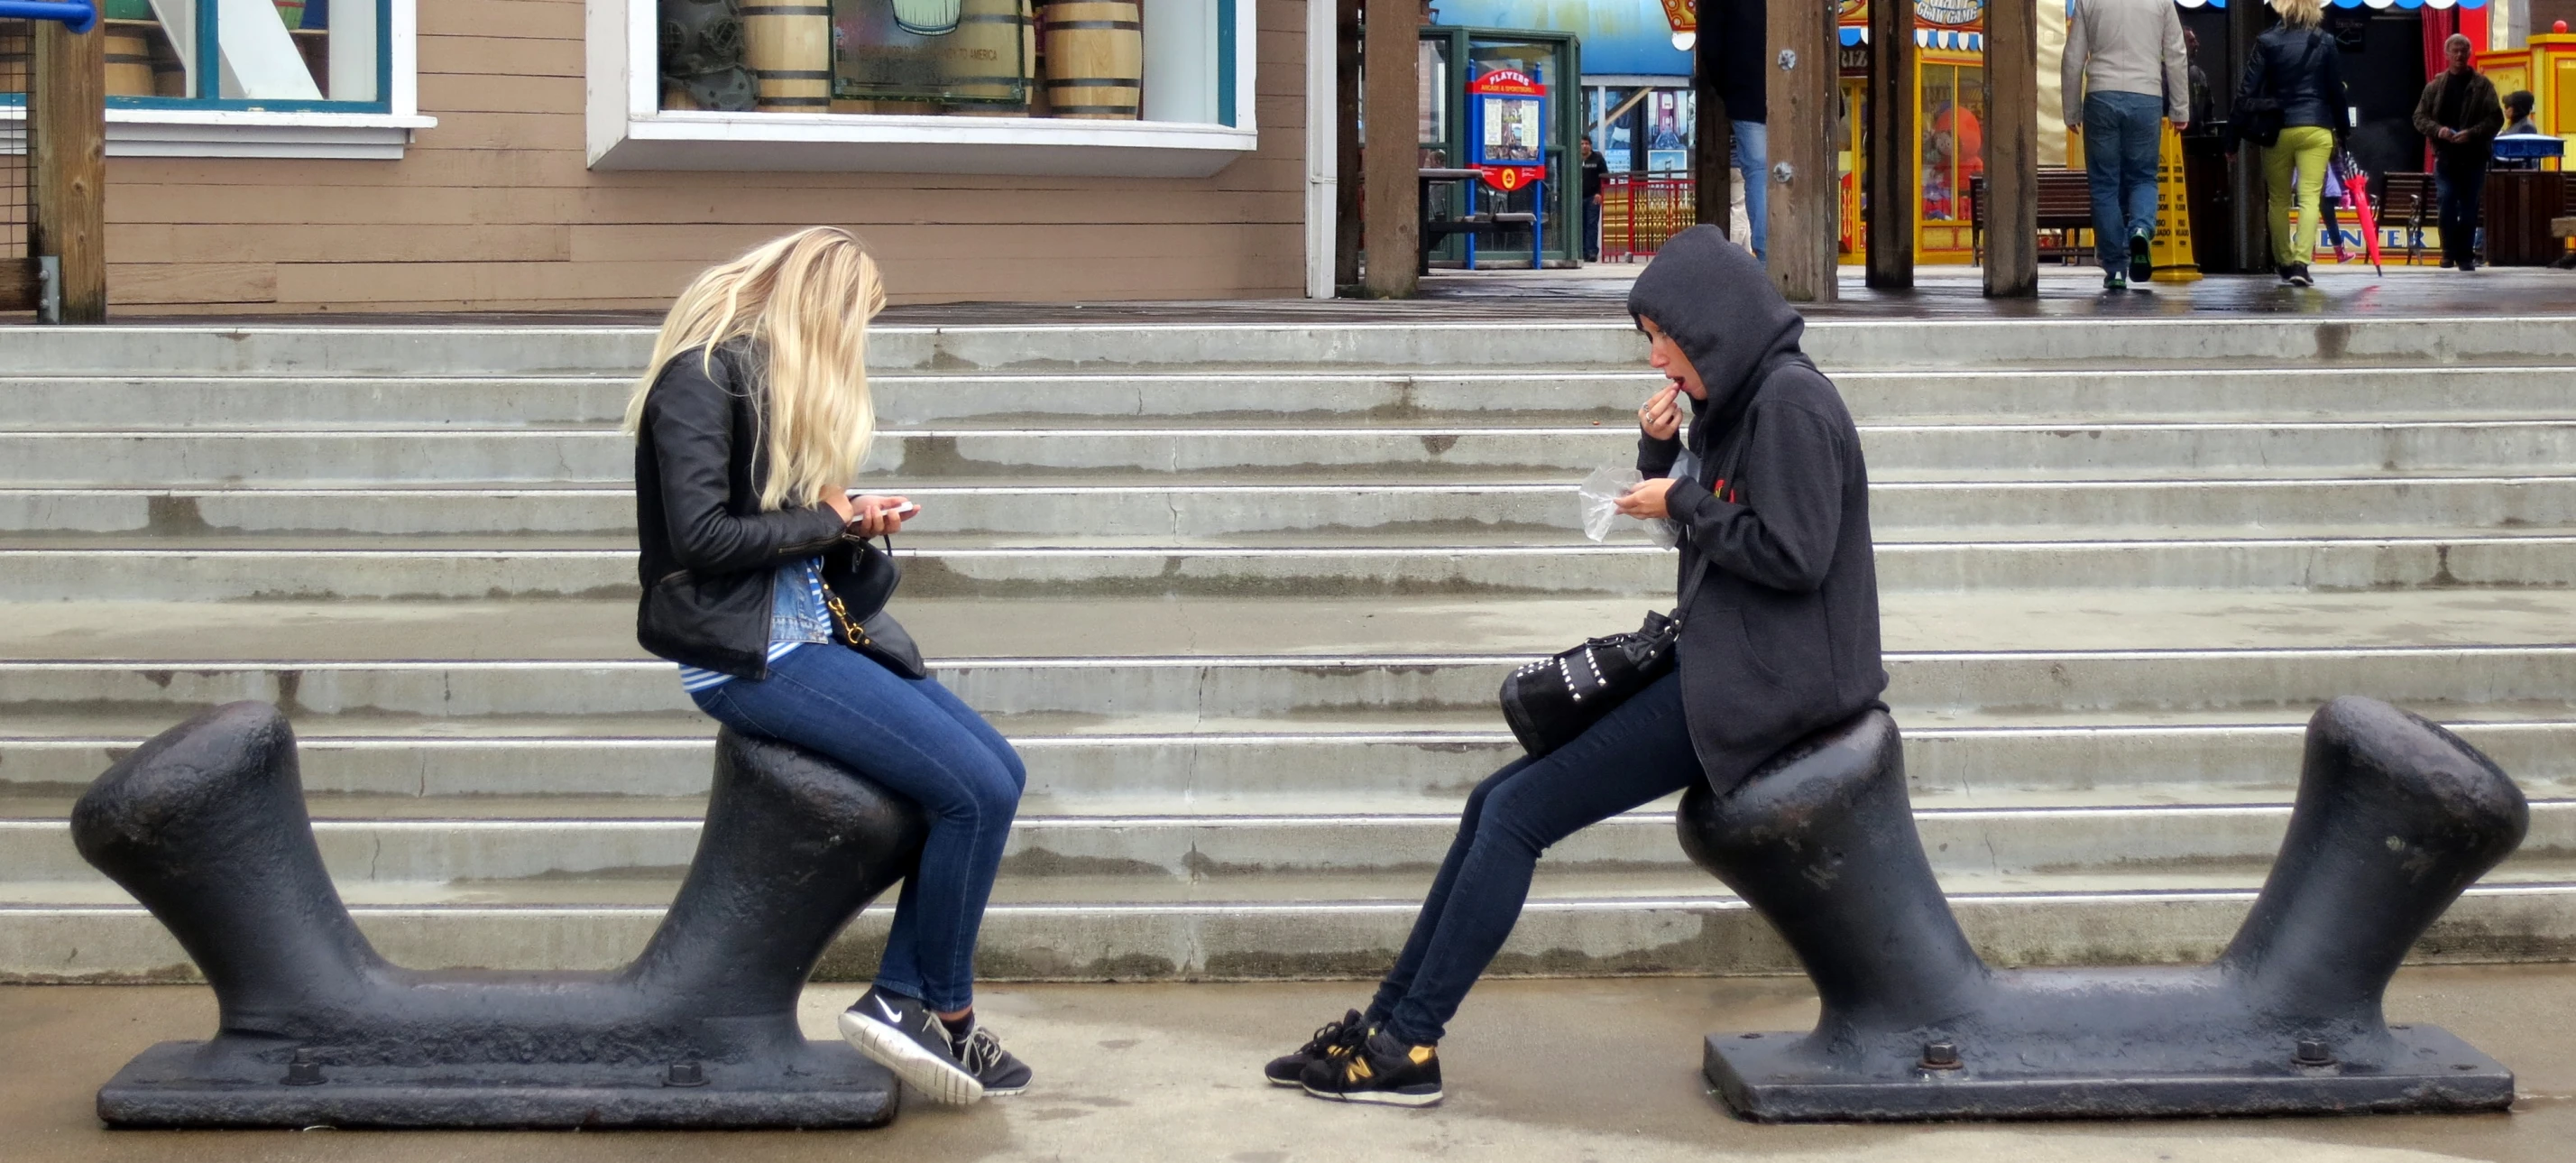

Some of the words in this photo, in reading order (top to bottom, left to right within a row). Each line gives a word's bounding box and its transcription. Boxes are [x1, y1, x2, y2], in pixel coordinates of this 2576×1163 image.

[1917, 2, 1946, 23] CLAW
[1946, 7, 1977, 24] GAME
[970, 49, 998, 61] AMERICA
[1489, 71, 1530, 87] PLAYERS
